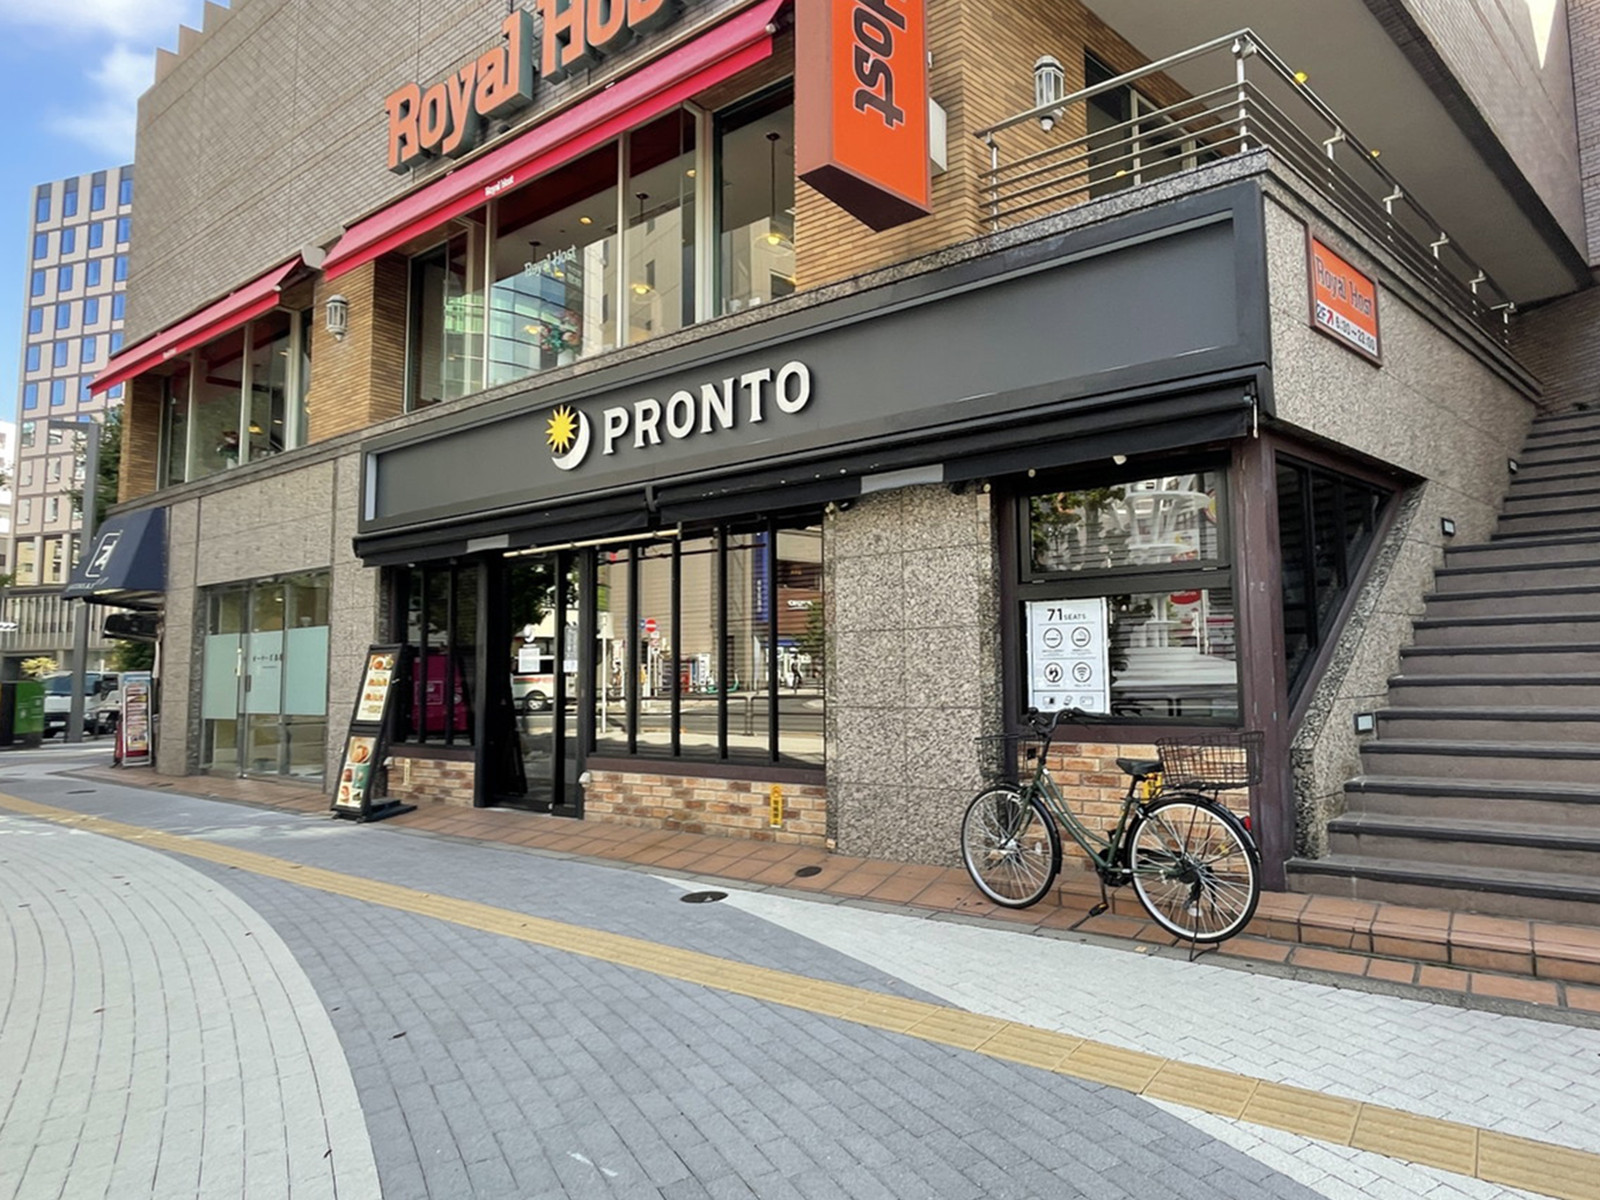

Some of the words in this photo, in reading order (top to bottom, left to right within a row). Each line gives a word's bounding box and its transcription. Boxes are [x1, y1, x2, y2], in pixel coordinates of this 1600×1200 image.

[384, 8, 523, 170] Royal
[1315, 255, 1346, 301] Royal
[1348, 281, 1373, 317] Host
[602, 361, 812, 456] PRONTO
[1047, 608, 1063, 621] 71
[1064, 613, 1086, 621] SEATS
